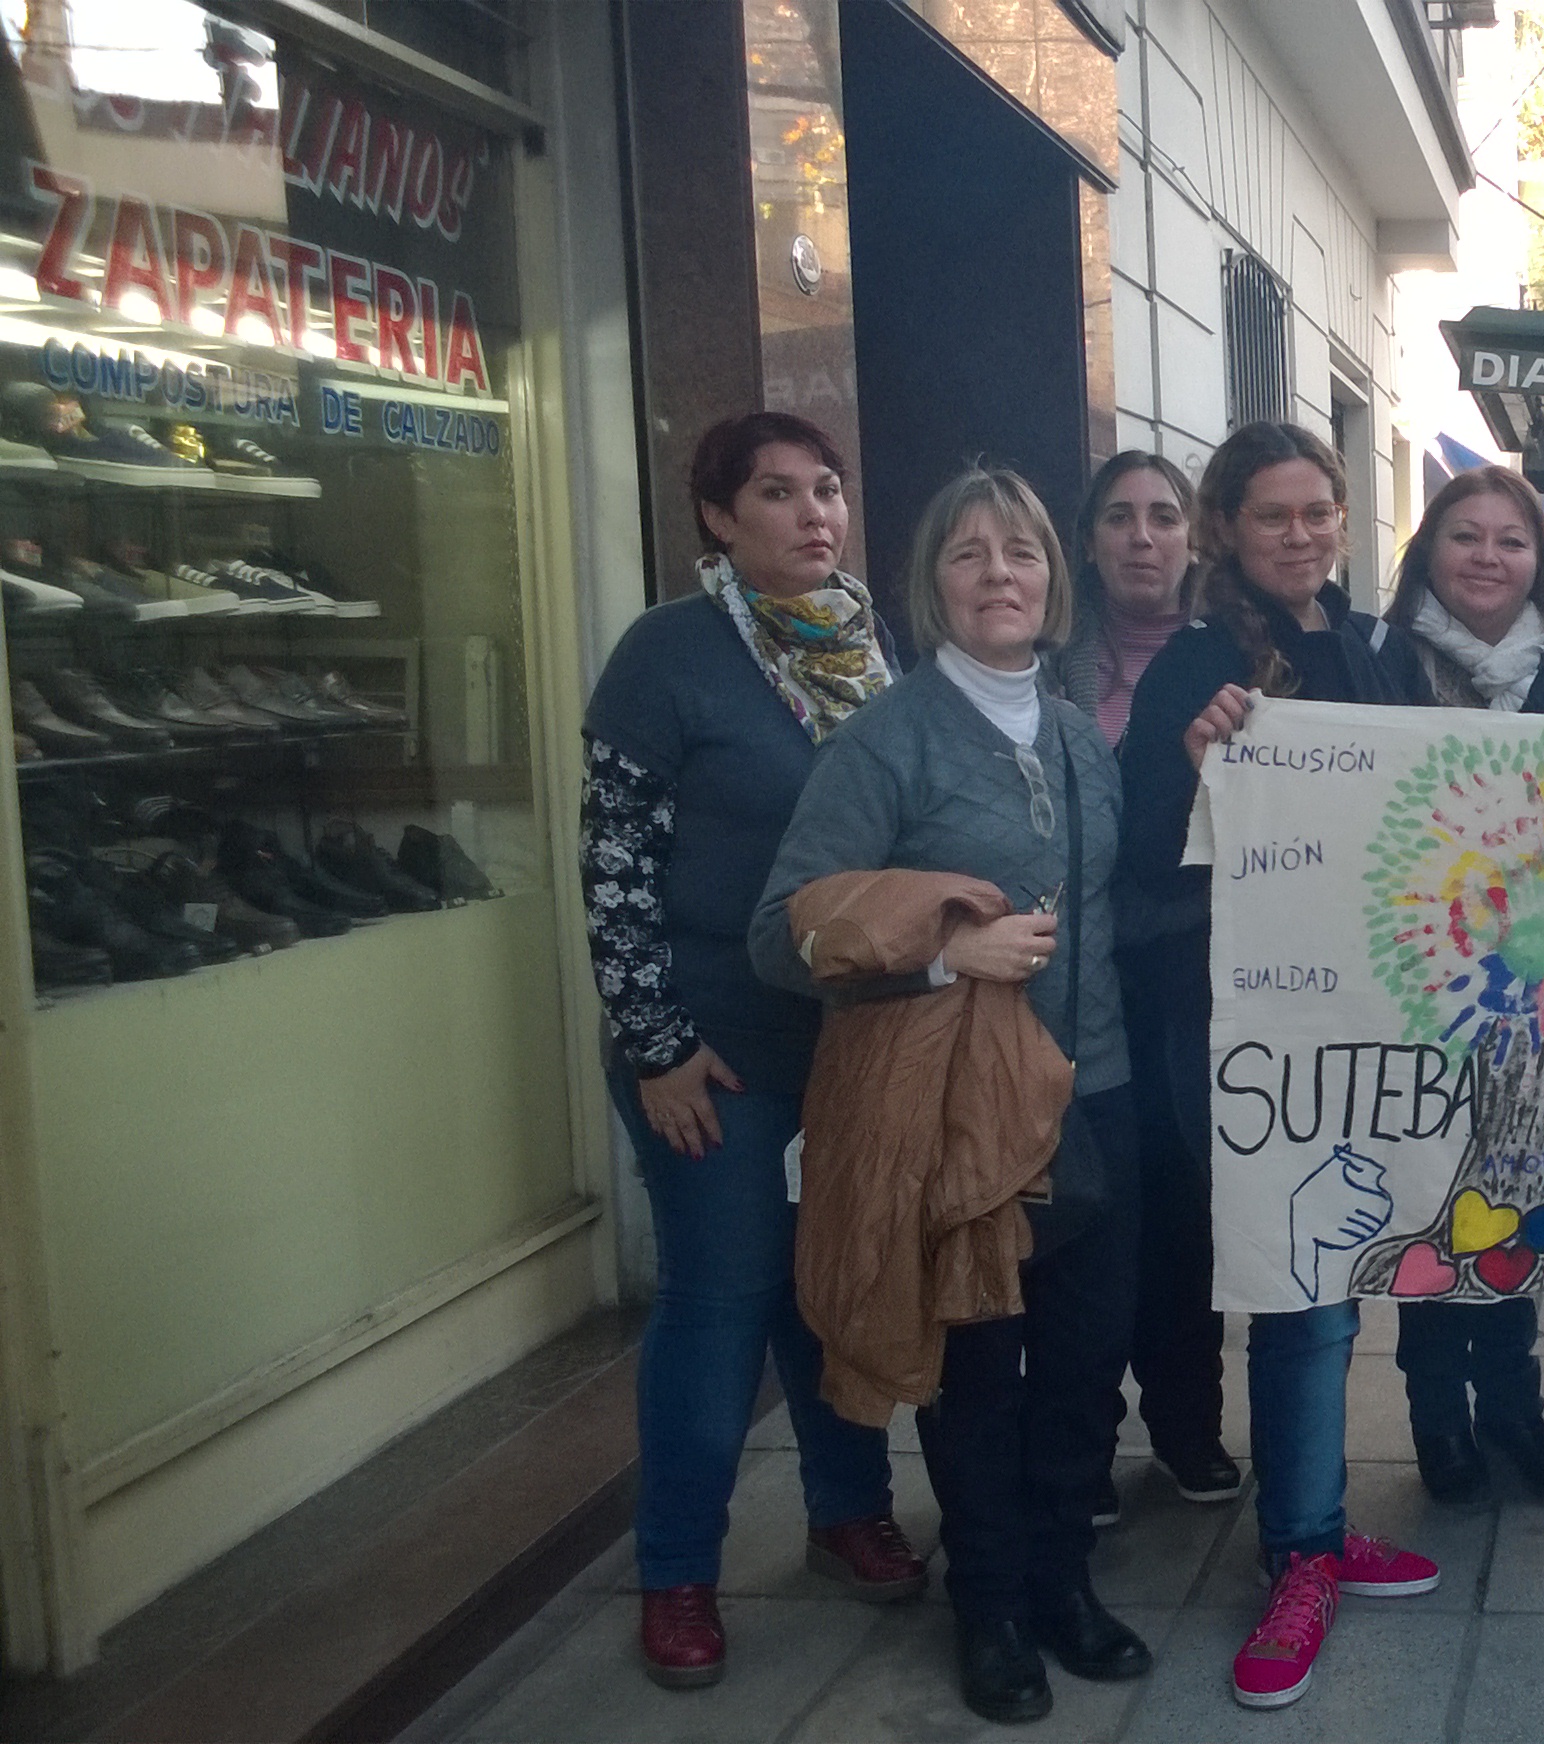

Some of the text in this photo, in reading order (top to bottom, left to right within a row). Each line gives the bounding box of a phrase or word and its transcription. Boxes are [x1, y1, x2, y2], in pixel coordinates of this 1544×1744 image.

[28, 158, 493, 400] ZAPATERIA
[41, 336, 300, 428] COMPOSTURA
[320, 386, 363, 438] DE
[382, 403, 500, 458] CALZADO
[1232, 965, 1339, 993] GUALDAD
[1217, 1041, 1478, 1156] SUTEBA
